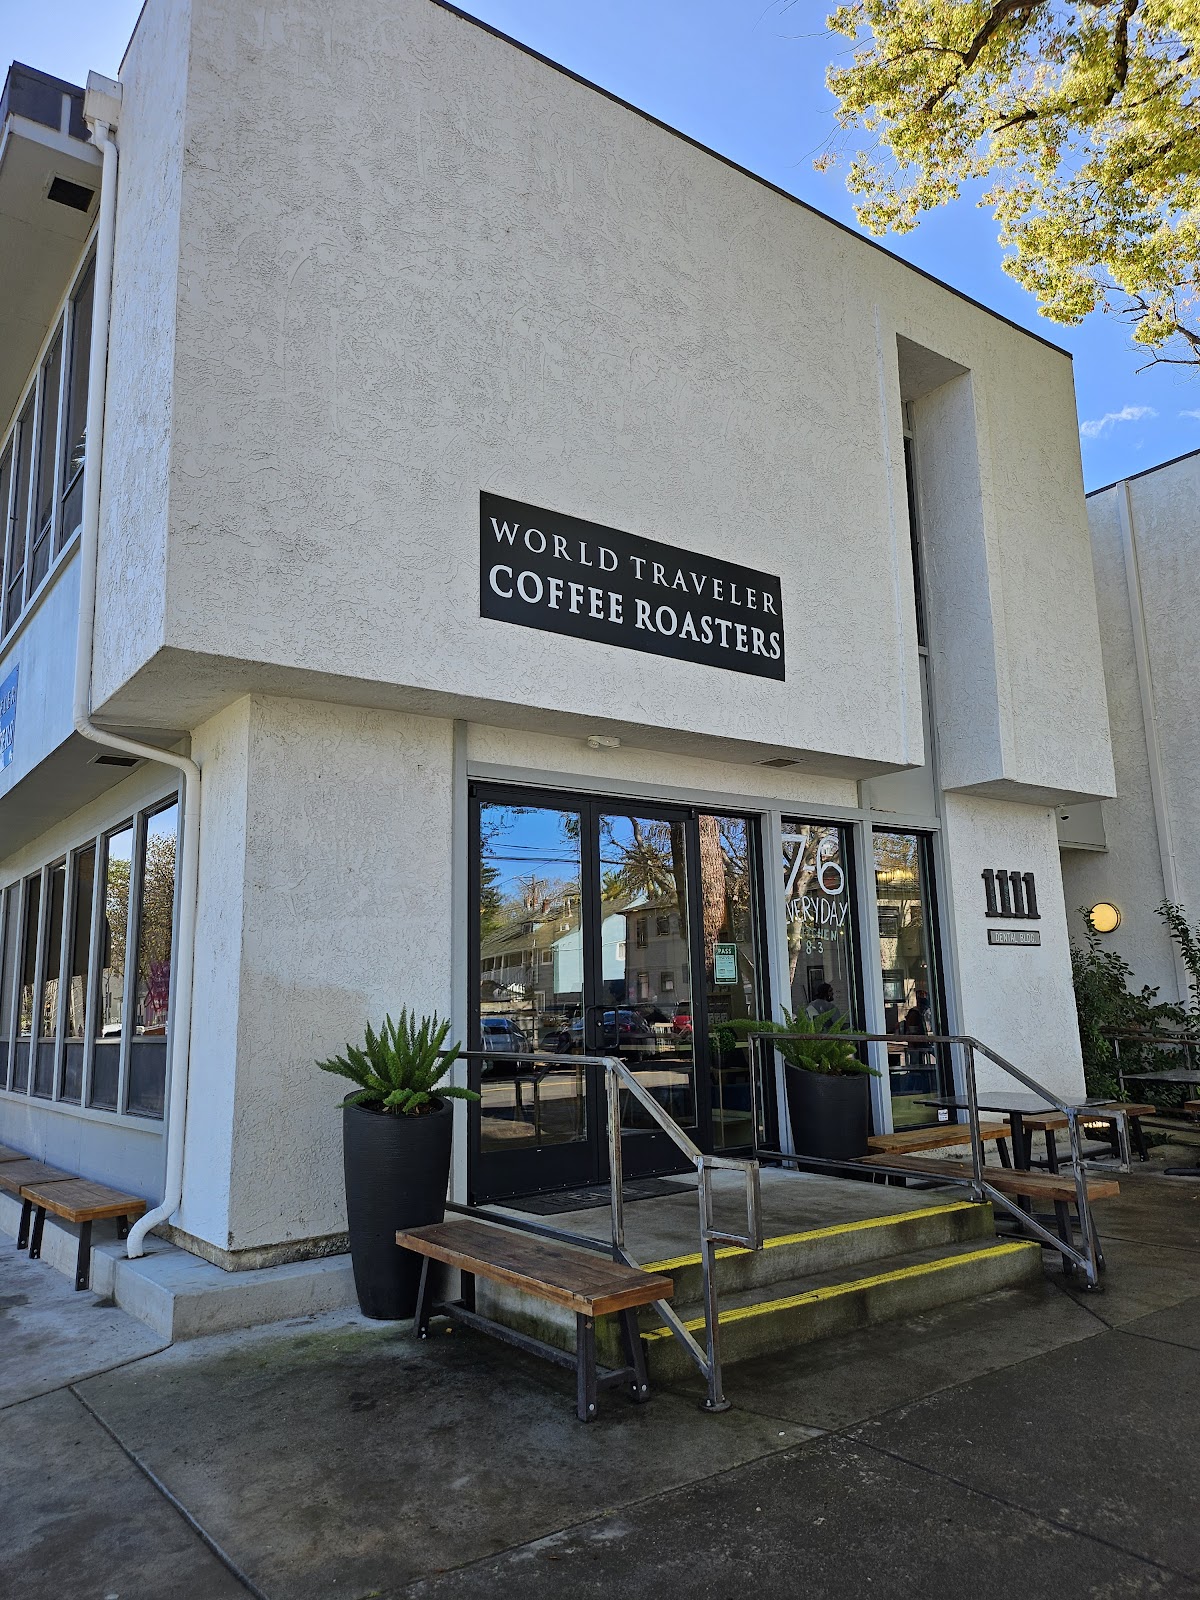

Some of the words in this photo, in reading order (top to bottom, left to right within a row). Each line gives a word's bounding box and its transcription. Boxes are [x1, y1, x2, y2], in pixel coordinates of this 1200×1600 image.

[489, 516, 619, 572] WORLD
[629, 555, 779, 616] TRAVELER
[489, 564, 624, 624] COFFEE
[635, 598, 781, 660] ROASTERS
[781, 834, 845, 895] 7-6
[786, 896, 848, 927] VERYDAY
[981, 868, 1041, 919] 1111
[806, 940, 824, 955] 8-3
[995, 932, 1018, 943] DENTAL
